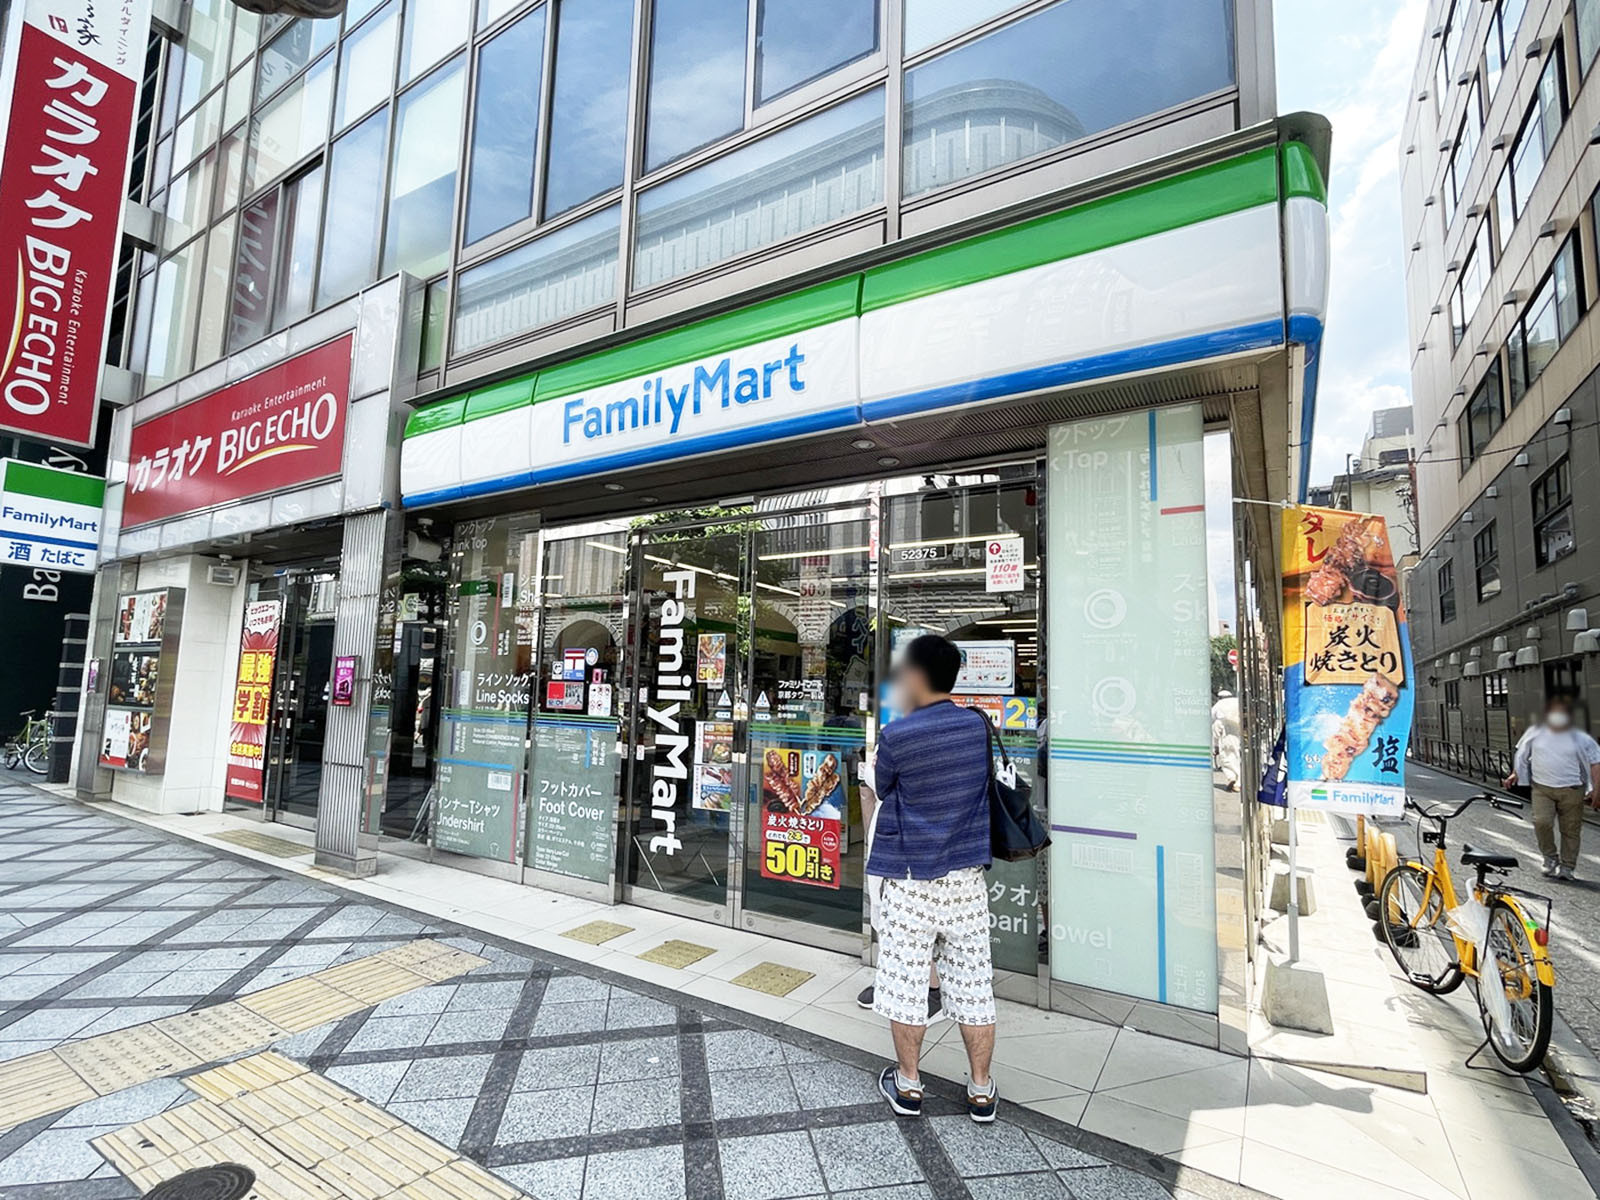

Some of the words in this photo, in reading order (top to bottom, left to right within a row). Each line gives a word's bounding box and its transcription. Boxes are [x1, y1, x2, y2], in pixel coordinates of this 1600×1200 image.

[24, 56, 109, 229] カラオケ
[26, 235, 71, 313] BIG
[71, 268, 88, 316] Karaoke
[4, 313, 59, 416] ECHO
[58, 319, 81, 405] Entertainment
[231, 403, 261, 422] Karaoke
[264, 376, 327, 408] Entertainment
[563, 342, 806, 444] FamilyMart
[217, 421, 262, 474] BIG
[265, 392, 338, 445] ECHO
[131, 435, 213, 495] カラオケ
[1063, 449, 1108, 469] Top
[2, 506, 98, 532] FamilyMart
[1301, 511, 1330, 563] タレ
[8, 541, 32, 562] 酒
[40, 548, 85, 567] たばこ
[901, 548, 937, 560] 52375
[1325, 624, 1381, 649] 炭火
[1310, 650, 1398, 673] 焼きとり
[476, 689, 497, 703] Line
[498, 689, 530, 705] Socks
[647, 570, 695, 856] FamilyMart
[1372, 735, 1401, 774] 塩
[541, 780, 602, 798] フットカバー
[1333, 790, 1395, 806] FamilyMart
[540, 797, 565, 815] Foot
[568, 801, 605, 821] Cover
[767, 814, 825, 831] 炭火焼きとり
[1051, 923, 1112, 950] owel
